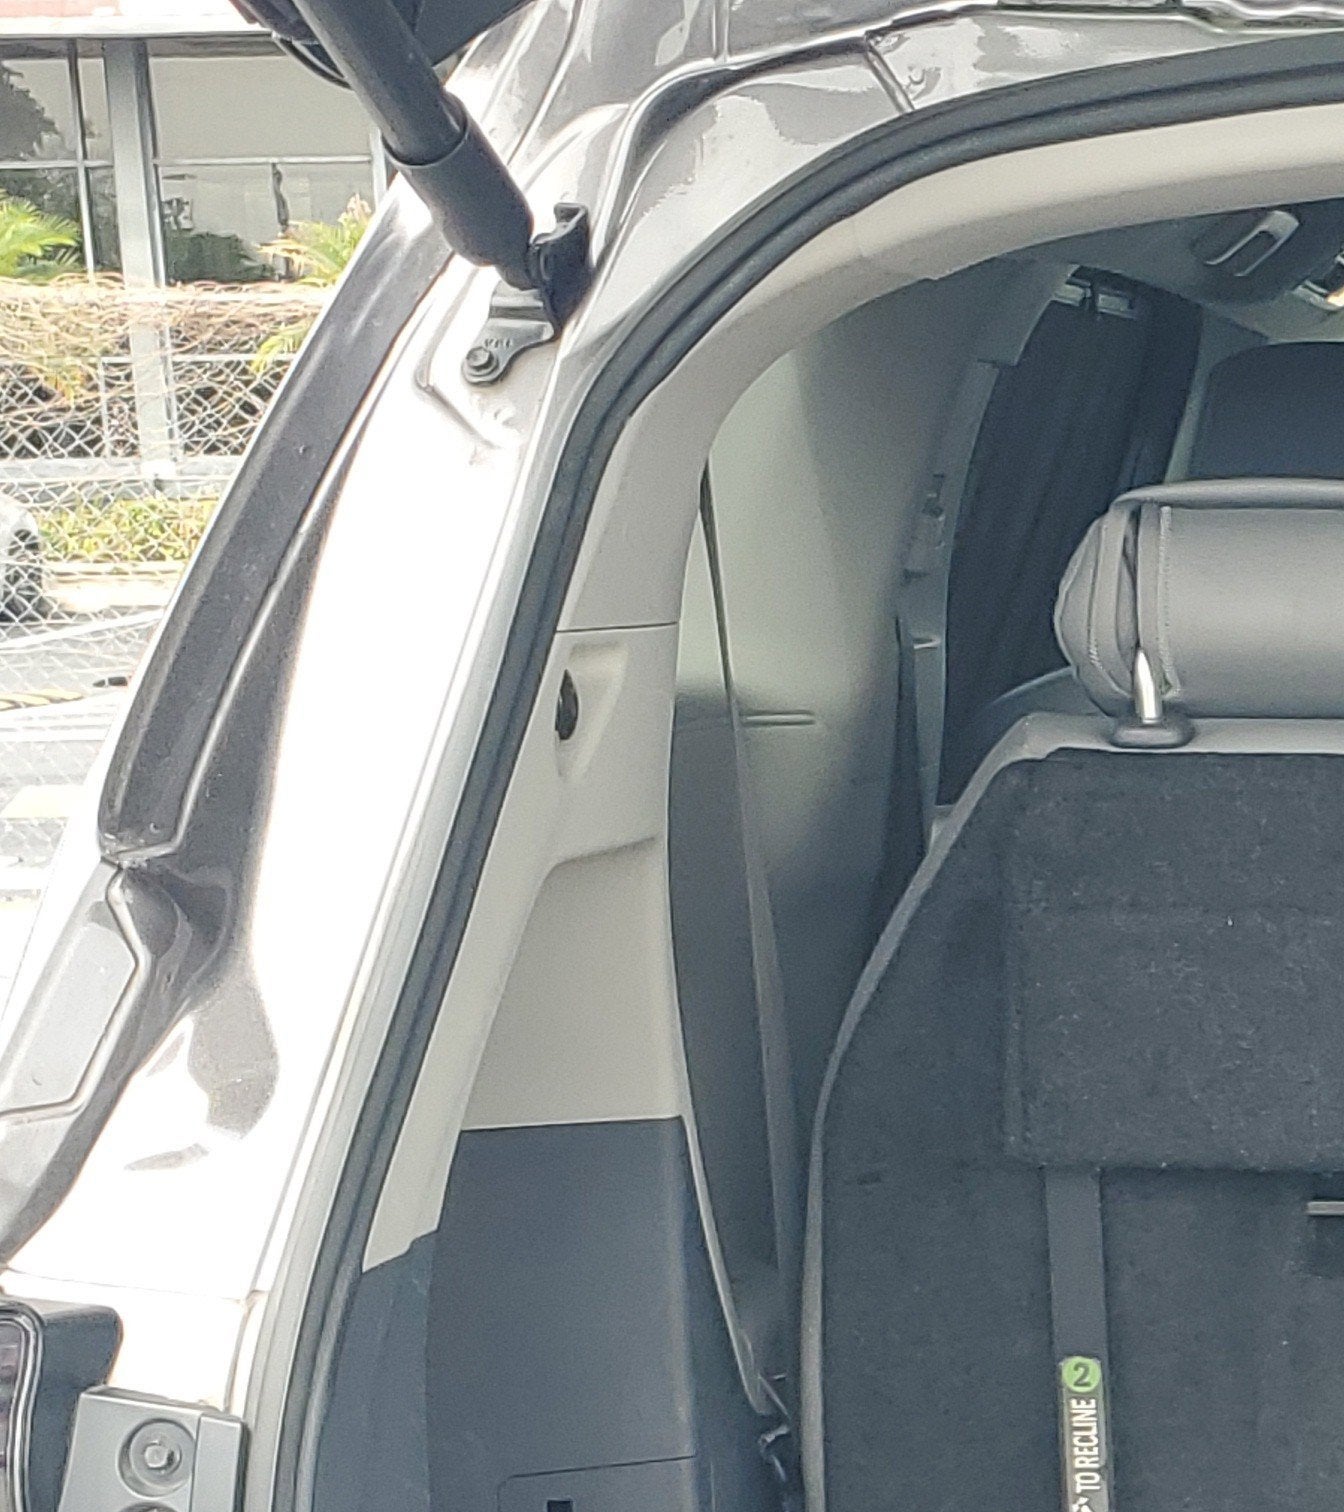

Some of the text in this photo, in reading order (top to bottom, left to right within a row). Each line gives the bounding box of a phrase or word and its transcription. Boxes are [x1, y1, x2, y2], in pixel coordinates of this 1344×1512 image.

[1072, 1362, 1092, 1387] 2
[1070, 1398, 1101, 1494] TO RECLINE
